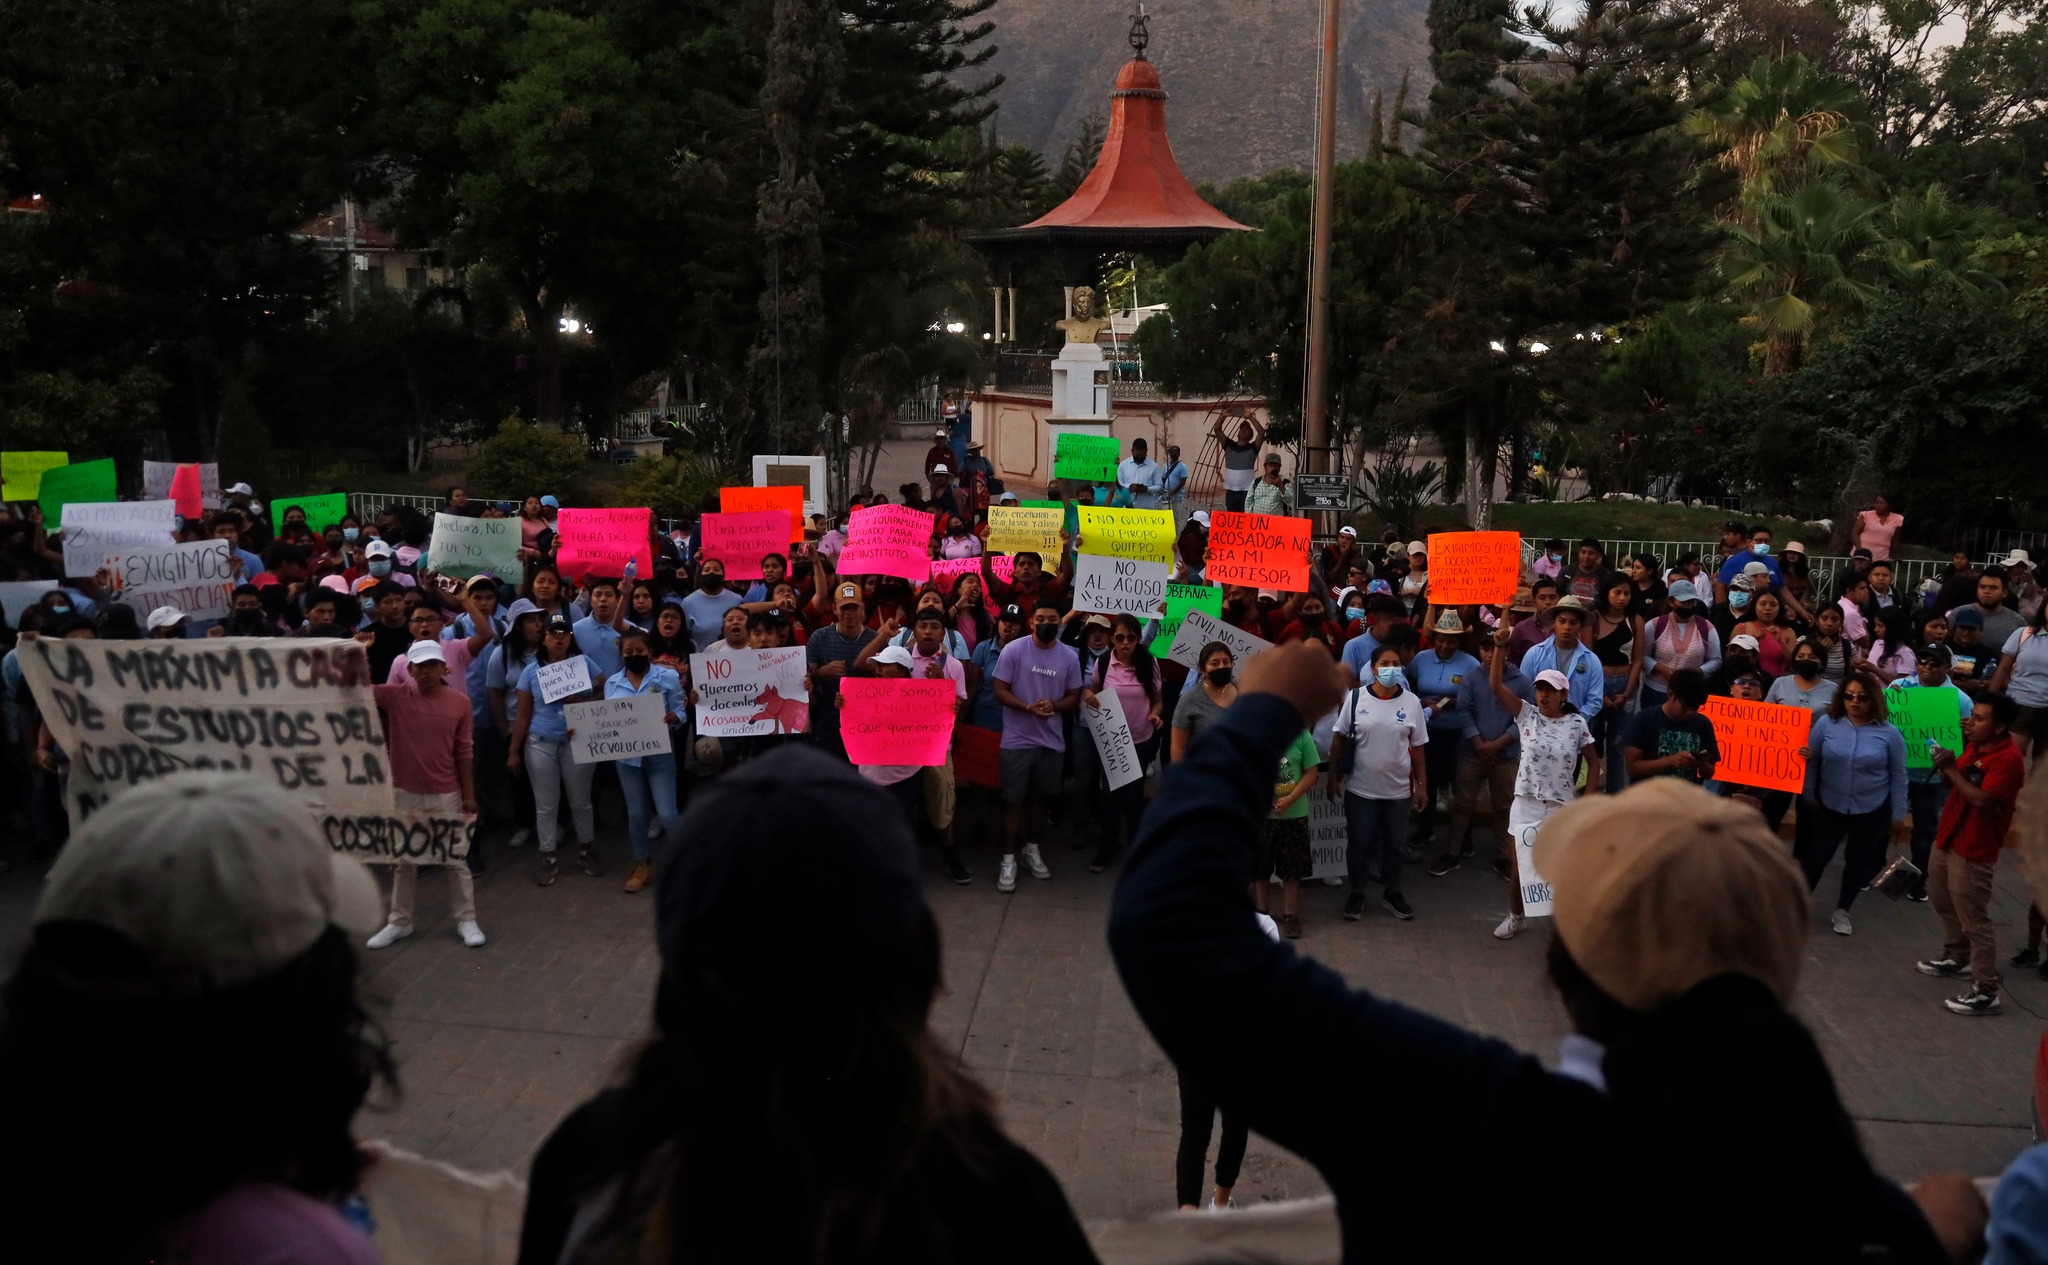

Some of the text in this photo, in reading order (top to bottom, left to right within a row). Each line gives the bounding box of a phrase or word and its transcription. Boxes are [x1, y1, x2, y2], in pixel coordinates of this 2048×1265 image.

[486, 522, 506, 535] NO
[708, 517, 776, 535] Para cuando
[1121, 516, 1165, 526] QUIERO
[1216, 513, 1271, 530] QUE UN
[608, 532, 630, 543] DEL
[890, 527, 913, 538] PARA
[1101, 527, 1158, 540] TU PIROPO
[1111, 541, 1155, 553] QUIERO
[1209, 531, 1311, 552] ACOSADOR NO
[1435, 537, 1491, 555] EXIGIMOS
[463, 545, 483, 557] YO
[1243, 550, 1264, 563] MI
[1115, 561, 1137, 576] NO
[1429, 555, 1505, 568] DE DOCENTES Y
[1085, 574, 1107, 590] AL
[1209, 565, 1291, 585] PROFESOR
[1462, 577, 1474, 586] NO
[1165, 584, 1213, 600] OBERNA-
[1187, 612, 1216, 637] CIVIL
[1218, 630, 1235, 646] NO
[36, 640, 94, 687] LA
[286, 652, 371, 689] CASA
[758, 652, 773, 661] NO
[539, 661, 578, 679] No fui yo
[565, 671, 576, 681] lo
[707, 659, 732, 680] NO
[1031, 665, 1057, 677] AeroNY
[699, 682, 759, 698] queremos
[900, 685, 954, 699] somos?
[1885, 689, 1909, 706] NO
[52, 688, 385, 746] DE ESTUDIOS DEL
[569, 702, 633, 721] SI NO HAY
[887, 721, 953, 736] queremos?
[1713, 720, 1790, 745] SIN FINES
[1715, 740, 1802, 781] OLITICOS
[273, 755, 326, 790] DE
[342, 752, 385, 784] LA
